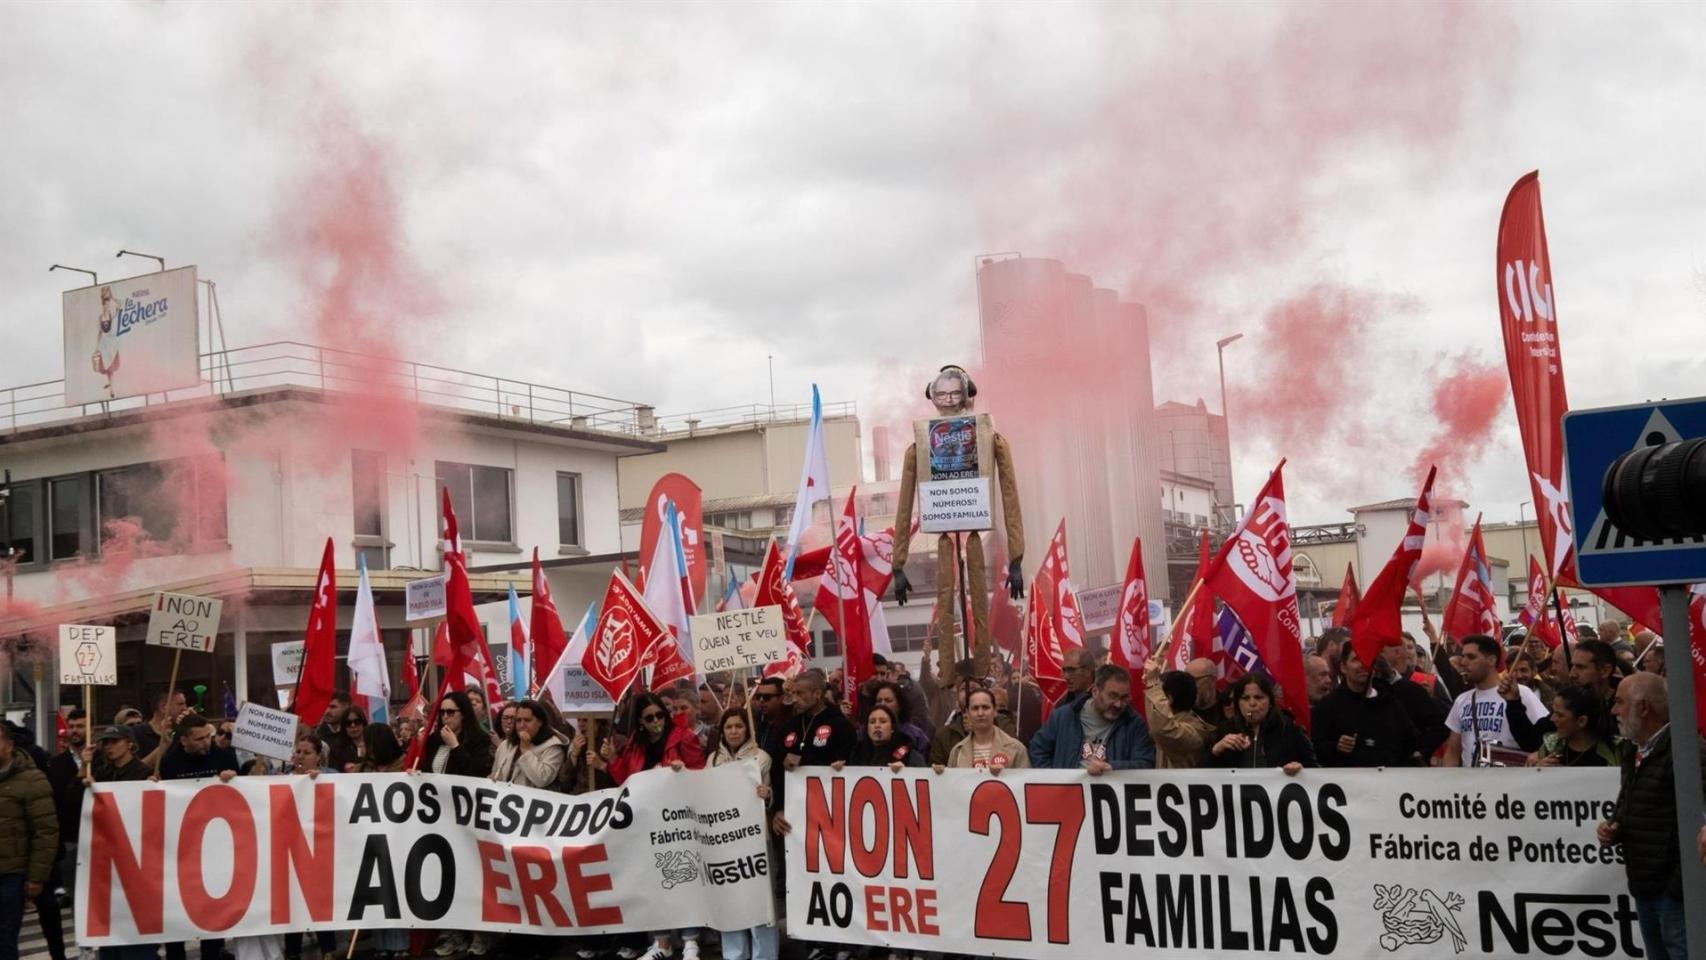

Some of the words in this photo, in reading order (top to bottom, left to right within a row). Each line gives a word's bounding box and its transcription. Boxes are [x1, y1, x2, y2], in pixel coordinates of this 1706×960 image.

[116, 297, 168, 336] Lechera
[931, 472, 947, 480] NON
[949, 471, 959, 479] AO
[949, 487, 979, 495] SOMOS
[922, 511, 951, 521] SOMOS
[952, 510, 989, 519] FAMILIAS
[172, 619, 199, 632] AO
[716, 608, 766, 631] NESTLÉ
[160, 631, 210, 651] ERE!
[699, 635, 730, 651] QUEN
[738, 632, 752, 642] TE
[756, 629, 778, 639] VEU
[736, 644, 744, 655] E
[79, 651, 96, 667] 27
[704, 655, 735, 671] QUEN
[742, 653, 757, 664] TE
[764, 650, 779, 660] VE
[64, 674, 116, 685] FAMILIAS
[565, 691, 590, 699] PABLO
[248, 708, 264, 718] NON
[265, 711, 291, 725] SOMOS
[1496, 702, 1504, 717] A
[236, 727, 261, 740] SOMOS
[261, 733, 293, 747] FAMILIAS
[349, 782, 441, 824] AOS
[451, 785, 634, 838] DESPIDOS
[1399, 792, 1486, 819] Comité
[1495, 793, 1526, 820] de
[1534, 797, 1617, 827] empre
[805, 776, 934, 880] NON
[1090, 782, 1350, 861] DESPIDOS
[650, 828, 692, 845] Fábrica
[86, 782, 335, 937] NON
[1369, 833, 1460, 861] Fábrica
[1469, 835, 1499, 861] de
[1507, 836, 1627, 865] Ponteces
[703, 852, 767, 886] Nestlé
[968, 779, 1086, 945] 27
[347, 834, 456, 921] AO
[477, 840, 624, 927] ERE
[806, 881, 853, 929] AO
[864, 885, 940, 936] ERE
[1099, 871, 1338, 955] FAMILIAS
[1477, 890, 1644, 958] Nest
